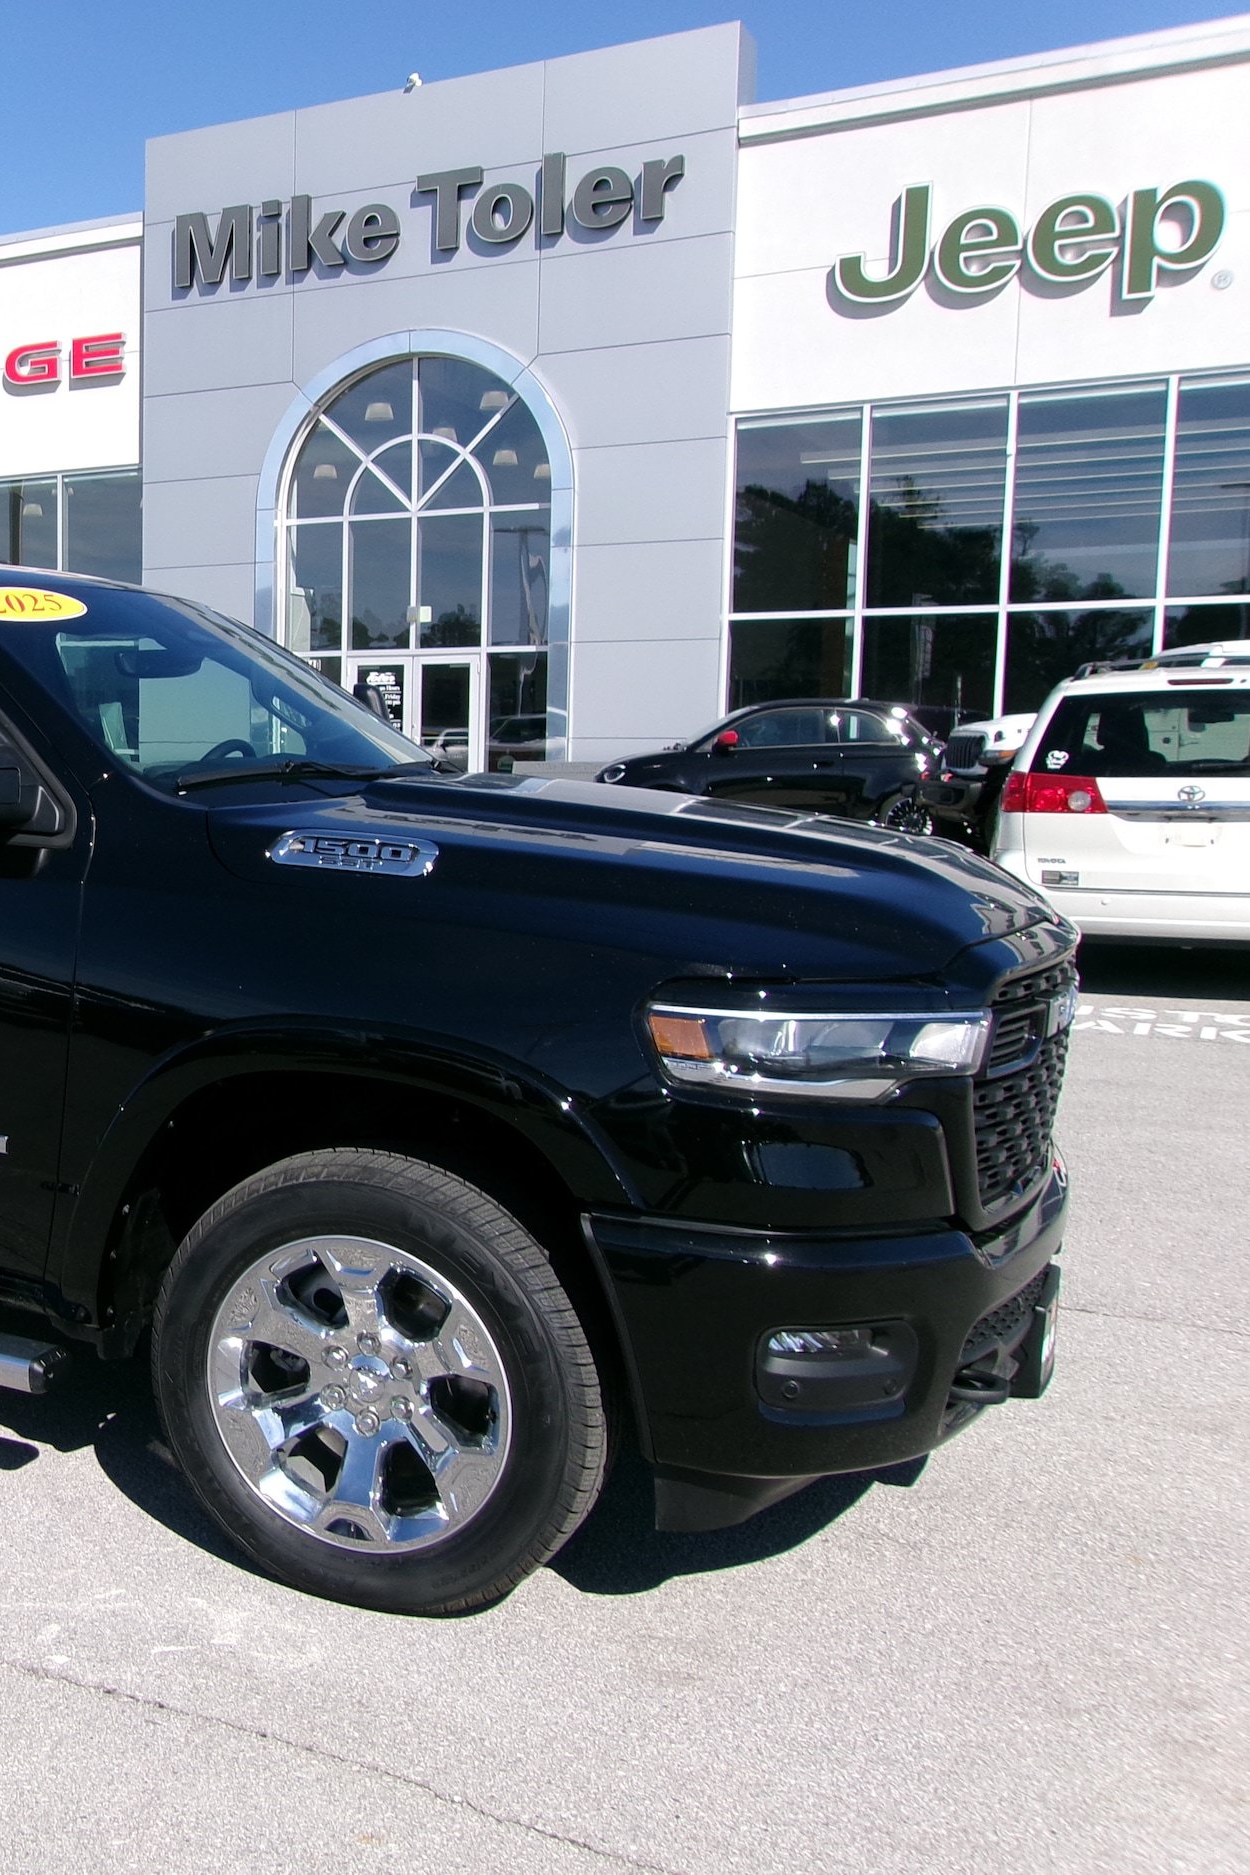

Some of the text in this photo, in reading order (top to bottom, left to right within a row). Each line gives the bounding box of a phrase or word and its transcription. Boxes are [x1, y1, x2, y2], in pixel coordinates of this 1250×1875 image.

[174, 151, 686, 289] Mike Toler
[834, 177, 1230, 303] Jeep
[300, 838, 413, 862] 1500
